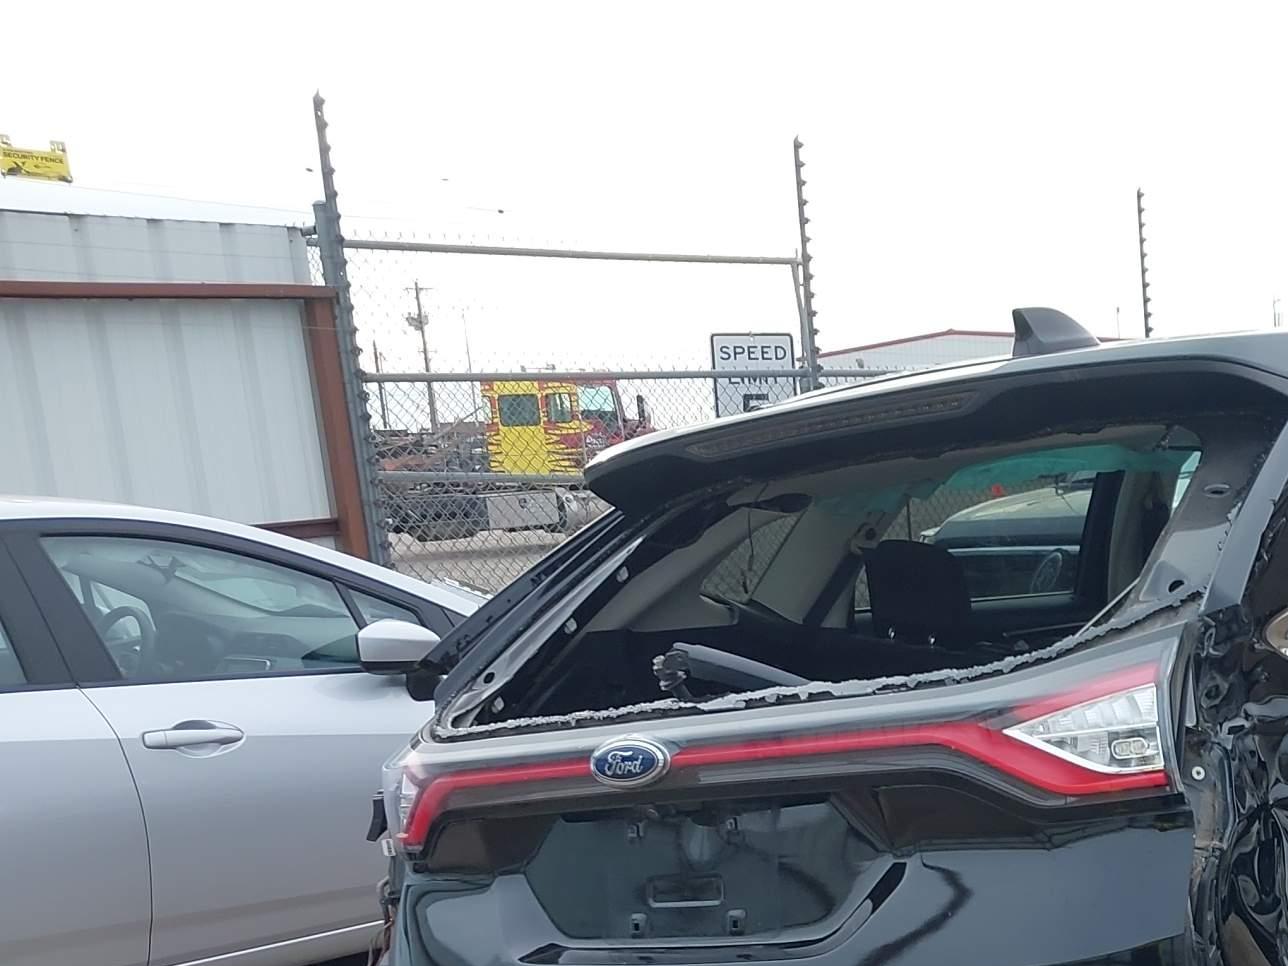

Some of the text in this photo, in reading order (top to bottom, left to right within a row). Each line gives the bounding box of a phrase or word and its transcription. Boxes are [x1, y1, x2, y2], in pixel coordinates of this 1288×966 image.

[3, 152, 65, 164] SECURITY FENCE
[719, 345, 787, 361] SPEED
[604, 750, 645, 776] Ford
